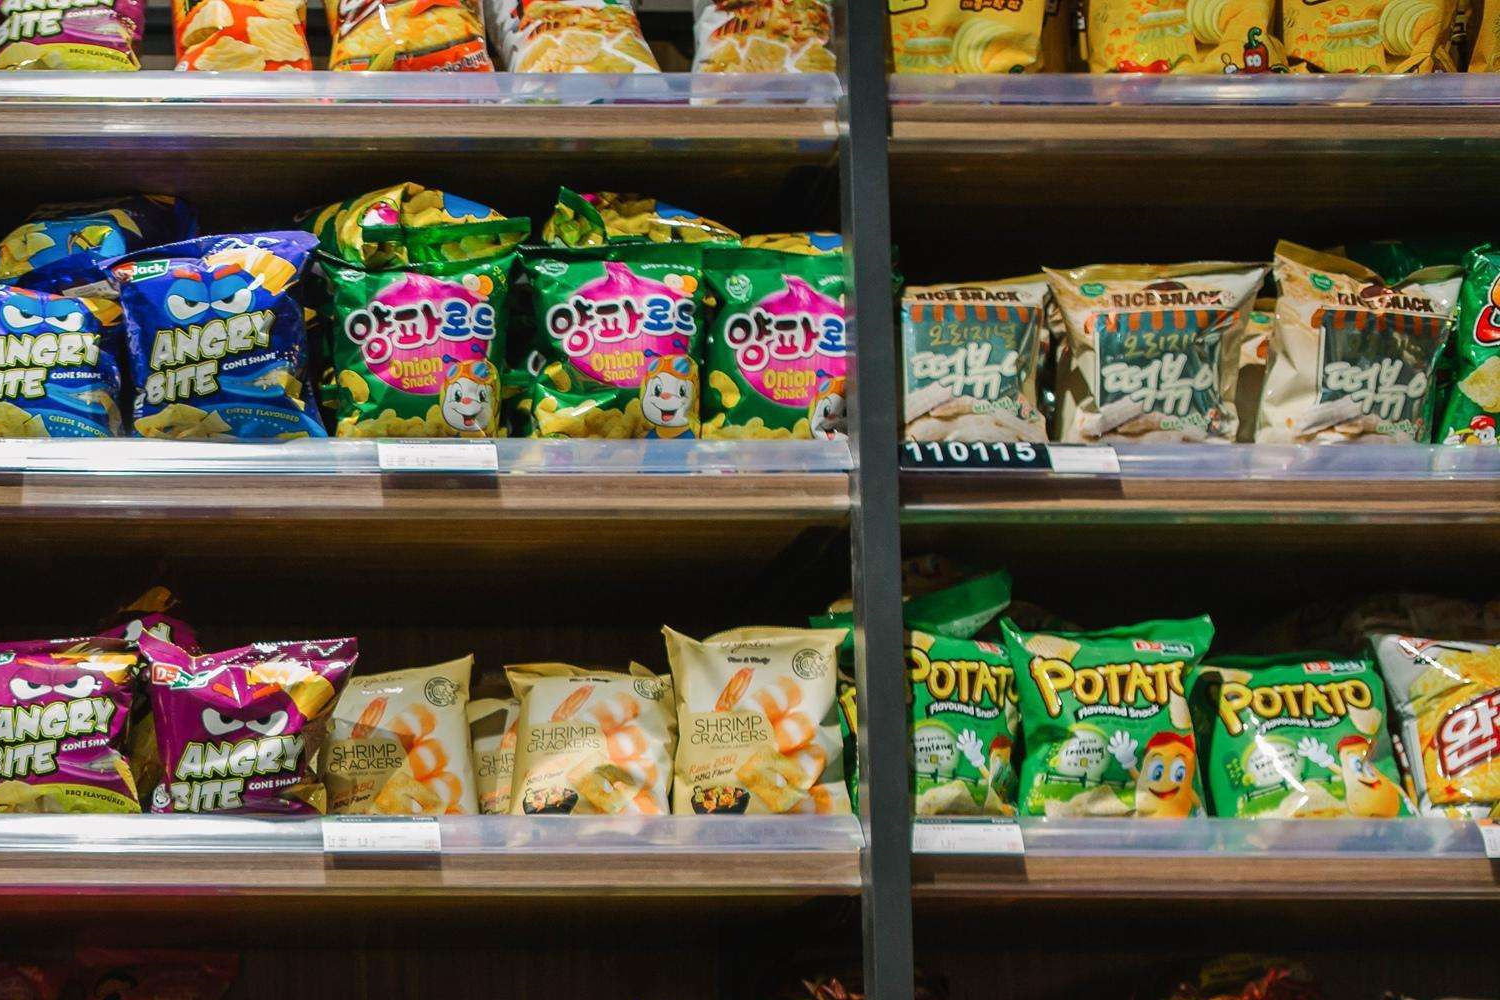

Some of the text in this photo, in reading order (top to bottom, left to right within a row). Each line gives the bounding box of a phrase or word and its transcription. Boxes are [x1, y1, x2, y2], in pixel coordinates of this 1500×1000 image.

[1112, 293, 1155, 308] RICE
[346, 298, 495, 364] 양파로드
[546, 296, 697, 358] 양파로드
[151, 310, 276, 370] ANGRY
[223, 353, 276, 371] CONE SHAPE
[389, 355, 444, 380] Onion
[590, 351, 645, 372] Onion
[146, 360, 219, 405] BITE
[403, 376, 438, 388] Snack
[603, 368, 638, 381] Snack
[763, 369, 817, 390] Onion
[773, 386, 808, 400] Snack
[255, 408, 300, 423] FLAVOURED
[905, 441, 1037, 462] 110115
[929, 702, 999, 719] Flavoured Snack
[1077, 703, 1160, 720] Flavoured Snack
[1218, 679, 1372, 736] POTATO
[695, 716, 763, 733] SHRIMP
[531, 726, 597, 742] SHRIMP
[690, 729, 768, 746] CRACKERS
[62, 741, 88, 751] CONE
[332, 743, 397, 761] SHRIMP
[526, 738, 600, 753] CRACKERS
[175, 736, 305, 781] ANGRY
[329, 756, 403, 773] CRACKERS
[249, 780, 274, 790] CONE
[65, 789, 126, 807] BBQ FLAVOURED
[172, 778, 245, 813] BITE
